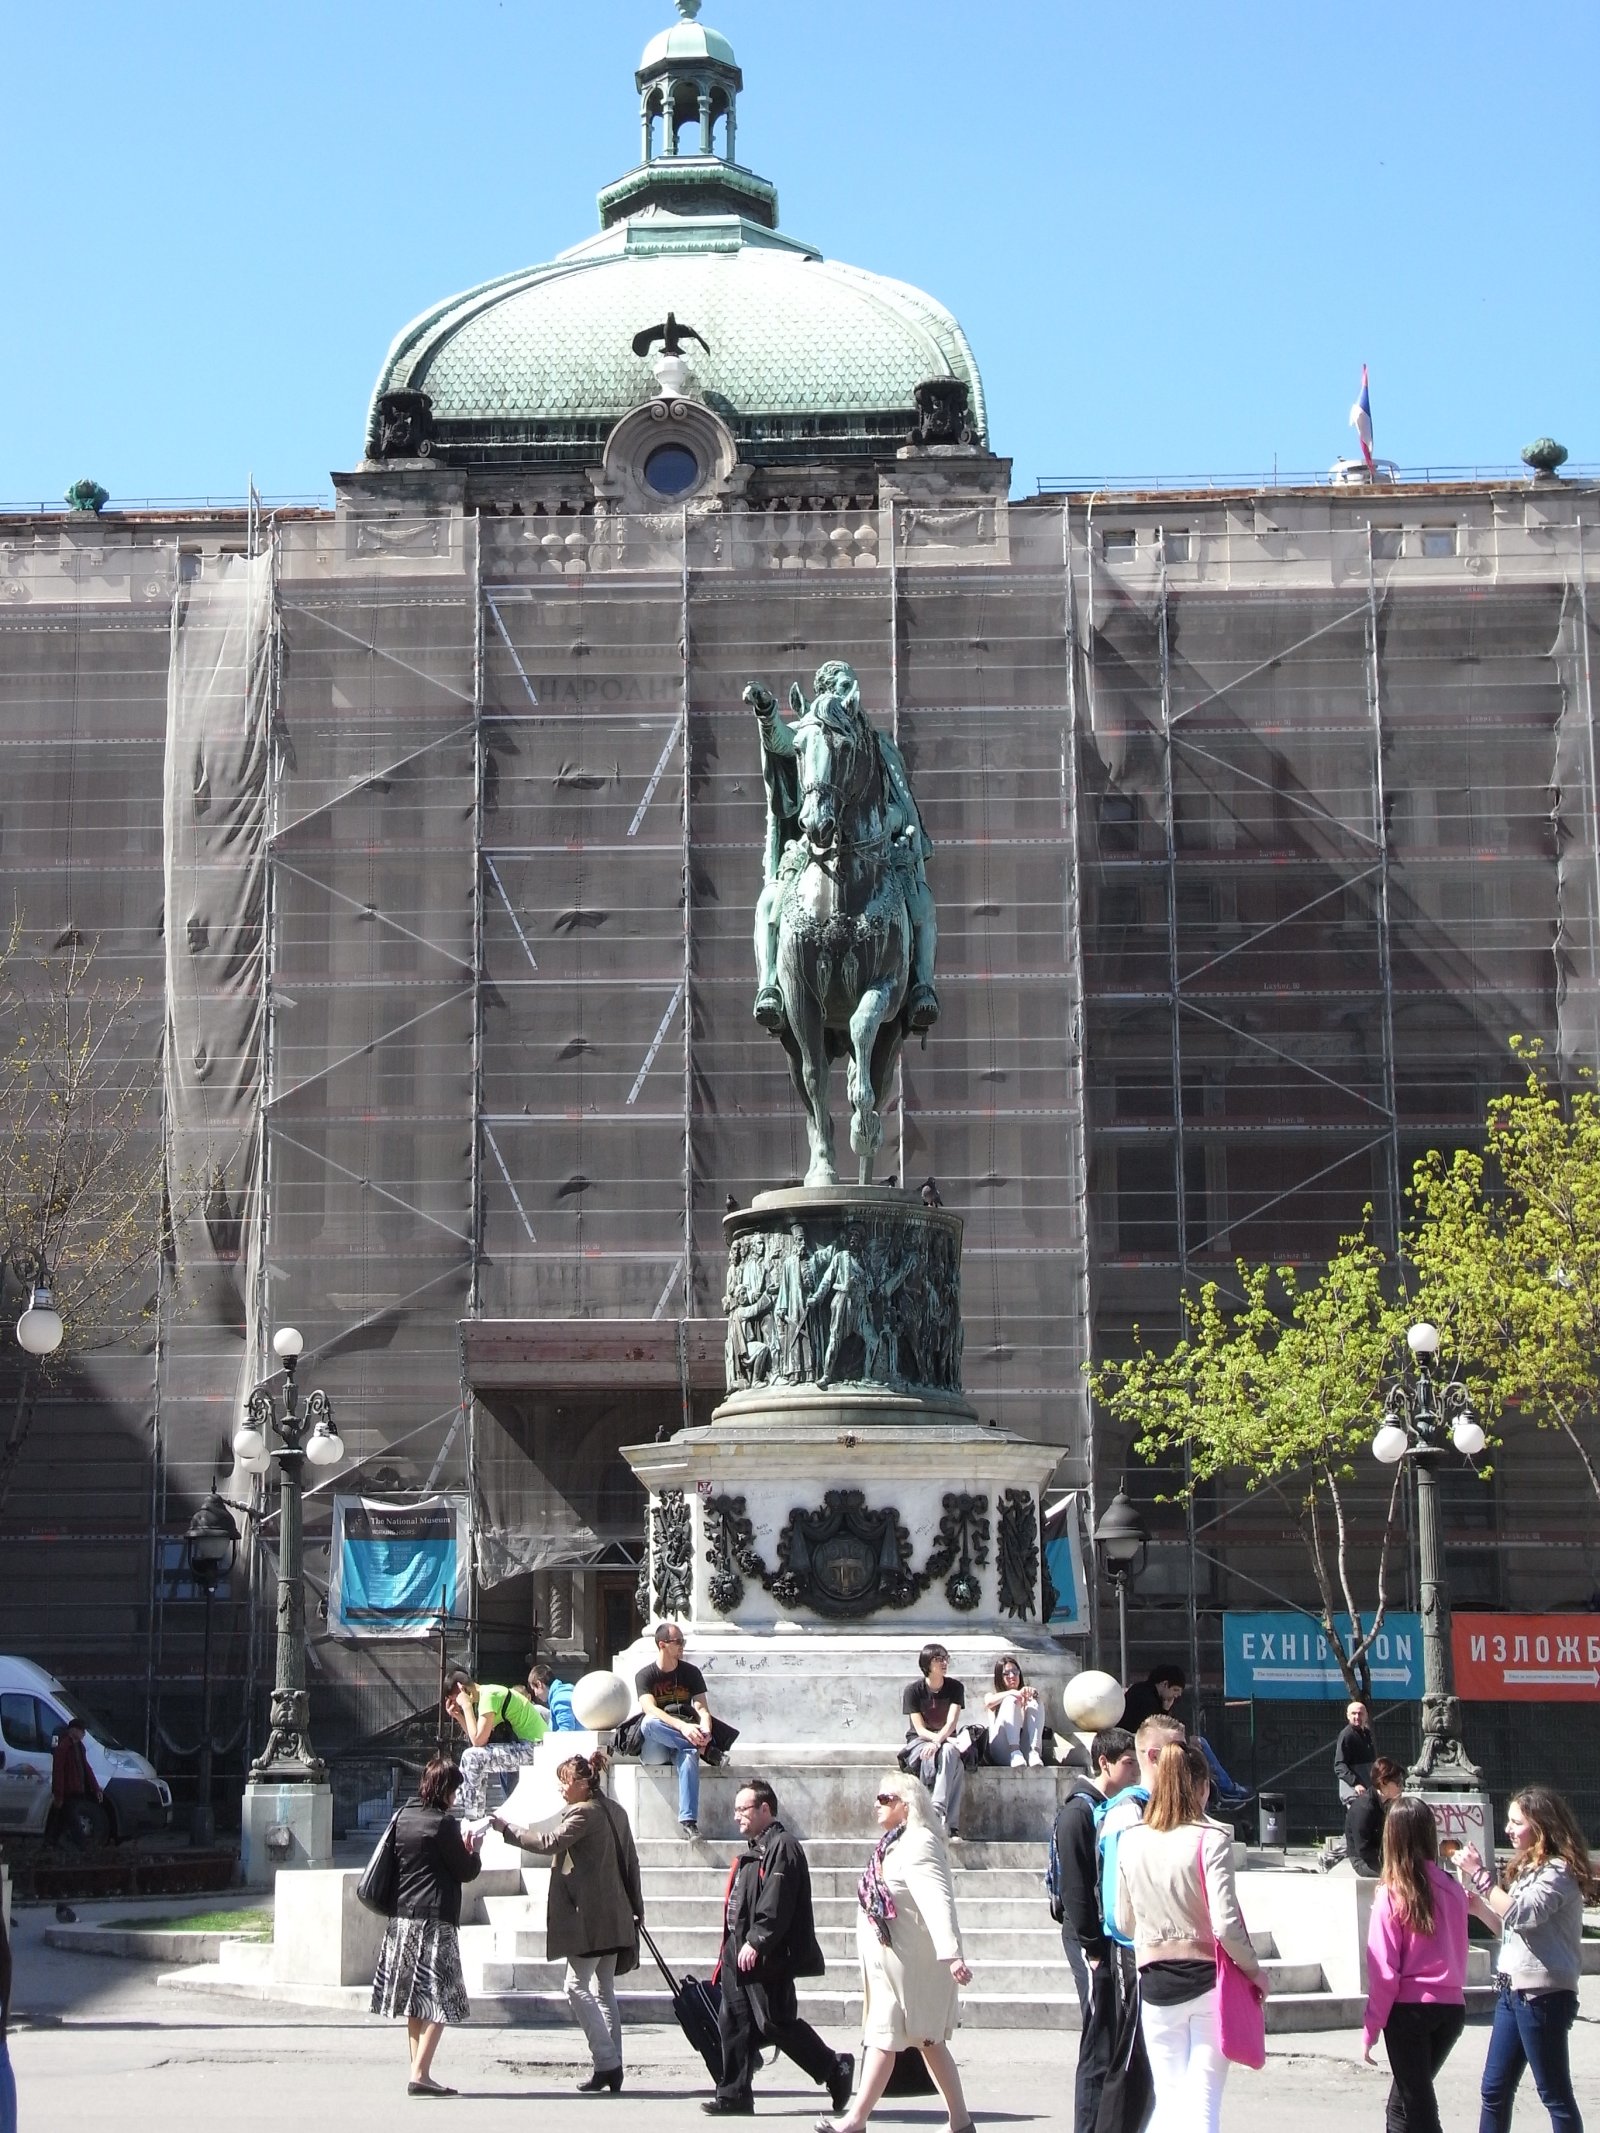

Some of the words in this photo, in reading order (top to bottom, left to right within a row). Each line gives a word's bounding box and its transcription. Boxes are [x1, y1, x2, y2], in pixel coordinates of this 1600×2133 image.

[371, 1517, 384, 1525] The
[387, 1517, 418, 1525] National
[1242, 1633, 1412, 1661] EXHIBTON
[1470, 1634, 1600, 1663] ИЗЛОЖБ
